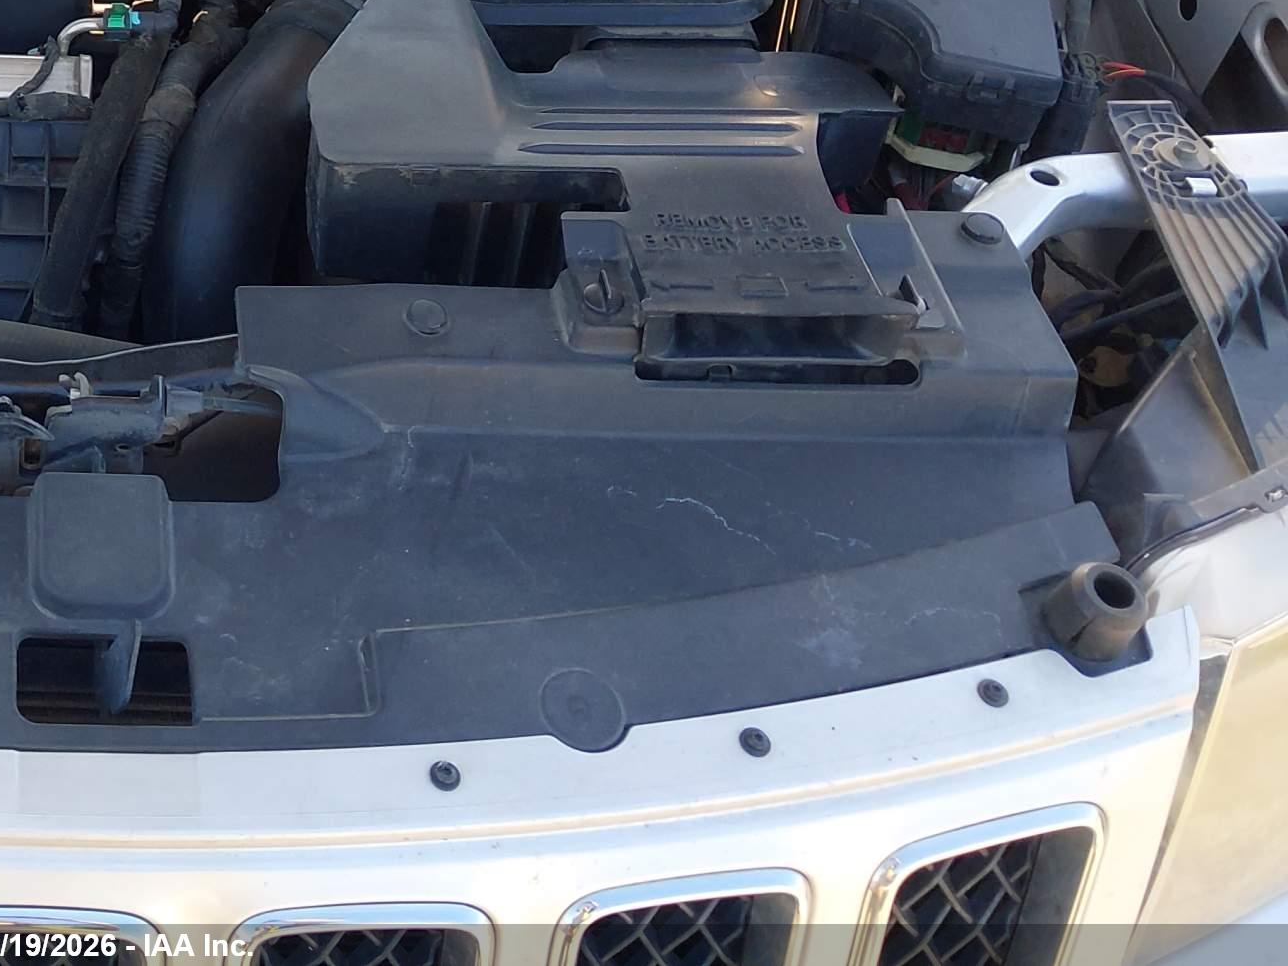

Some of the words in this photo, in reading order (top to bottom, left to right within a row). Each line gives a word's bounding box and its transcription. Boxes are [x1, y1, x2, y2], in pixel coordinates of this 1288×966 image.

[654, 212, 753, 231] REMOVE
[759, 215, 810, 231] FOR
[641, 233, 743, 253] BATTERY
[752, 235, 846, 253] ACCESS
